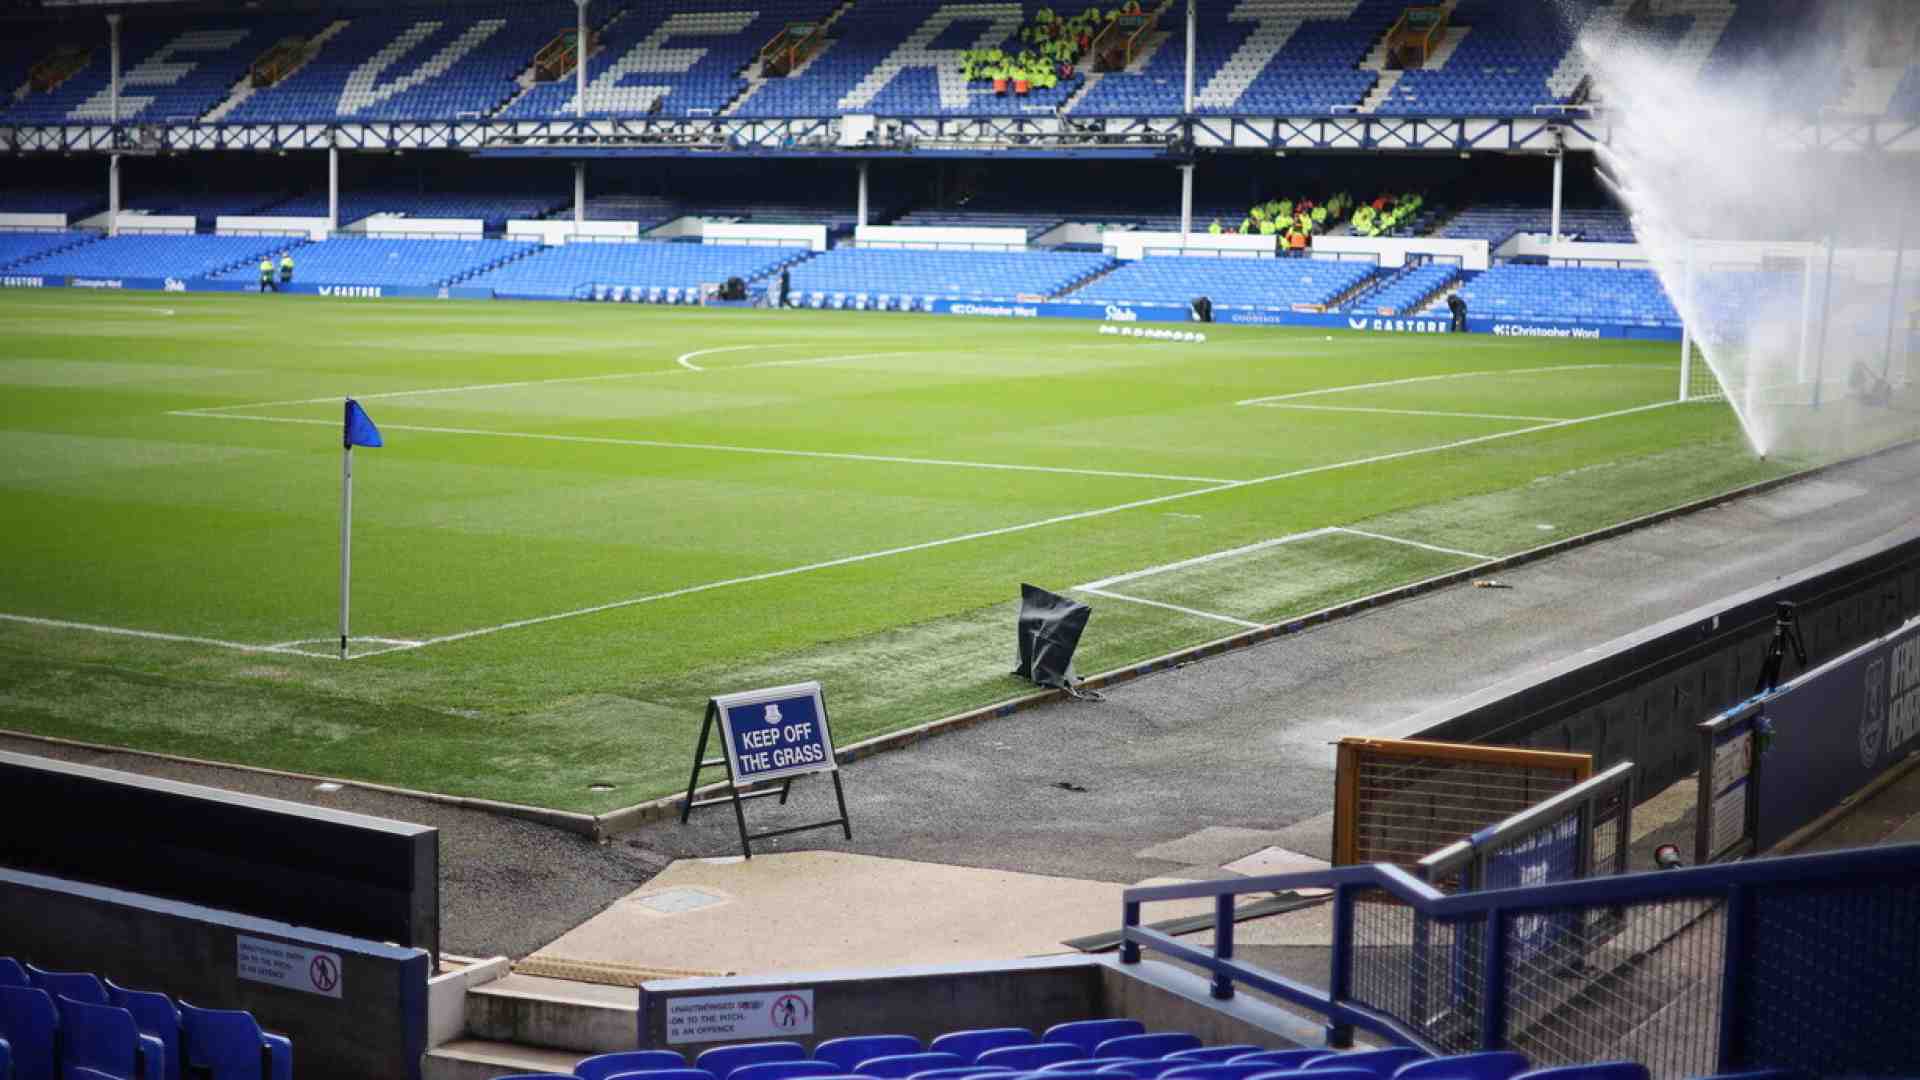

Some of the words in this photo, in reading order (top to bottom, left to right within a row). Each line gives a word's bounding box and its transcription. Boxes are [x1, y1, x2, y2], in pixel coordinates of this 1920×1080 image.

[1373, 318, 1447, 333] CASTORE
[1511, 324, 1570, 339] Christopher
[1572, 326, 1600, 339] Ward
[742, 728, 780, 750] KEEP
[783, 722, 812, 743] OFF
[740, 752, 771, 772] THE
[773, 743, 824, 767] GRASS
[671, 1017, 685, 1025] ON
[687, 1016, 698, 1024] TO
[701, 1014, 715, 1023] THE
[719, 1013, 744, 1022] PITCH
[683, 1027, 695, 1035] AN
[696, 1025, 735, 1034] OFFENCE
